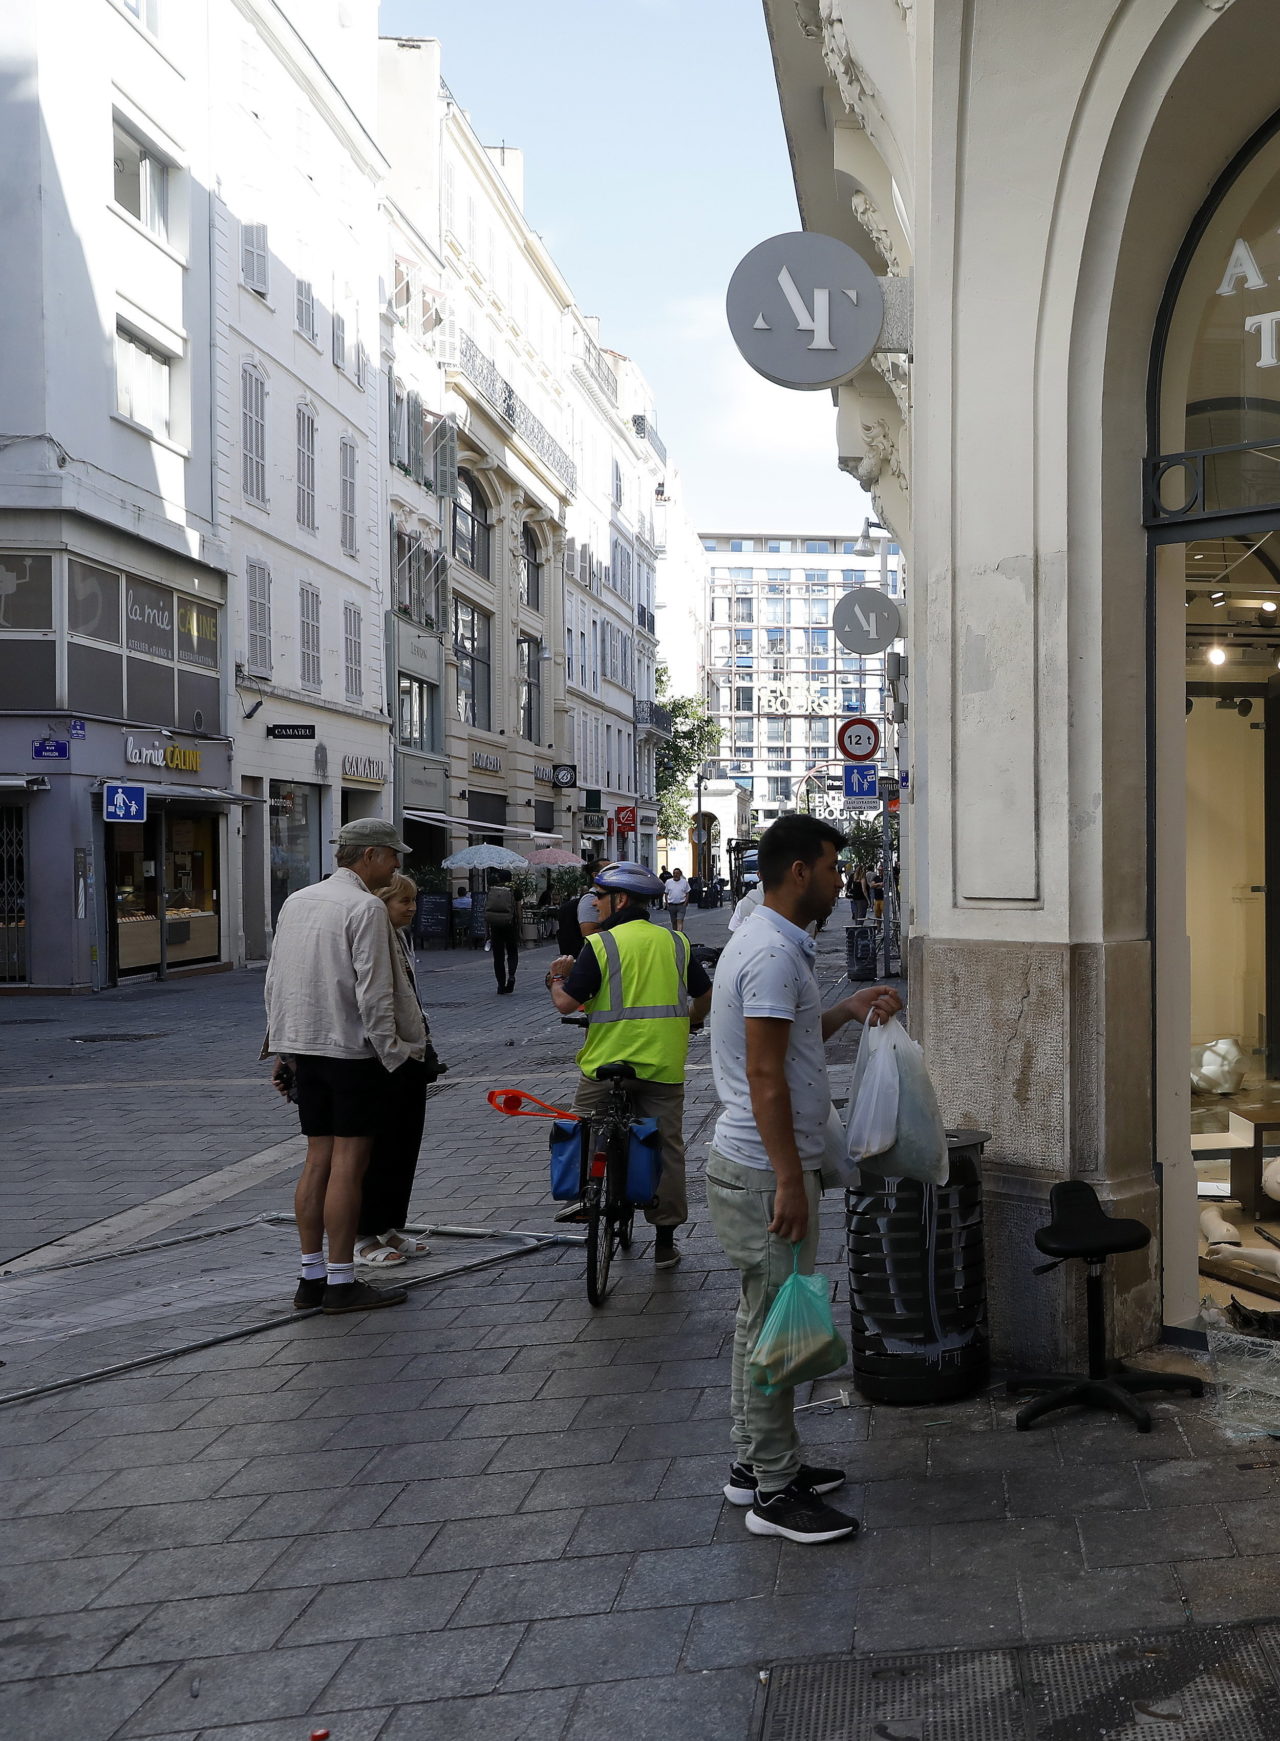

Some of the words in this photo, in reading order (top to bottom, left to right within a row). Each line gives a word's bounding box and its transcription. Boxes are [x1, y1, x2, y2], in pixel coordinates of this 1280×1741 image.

[128, 590, 142, 620] la
[145, 601, 171, 630] mie
[128, 640, 149, 652] ATELIER
[761, 695, 842, 715] BOURSE
[847, 735, 862, 745] 12
[867, 736, 872, 745] t
[141, 741, 166, 766] mie
[165, 743, 204, 771] CÂLINE
